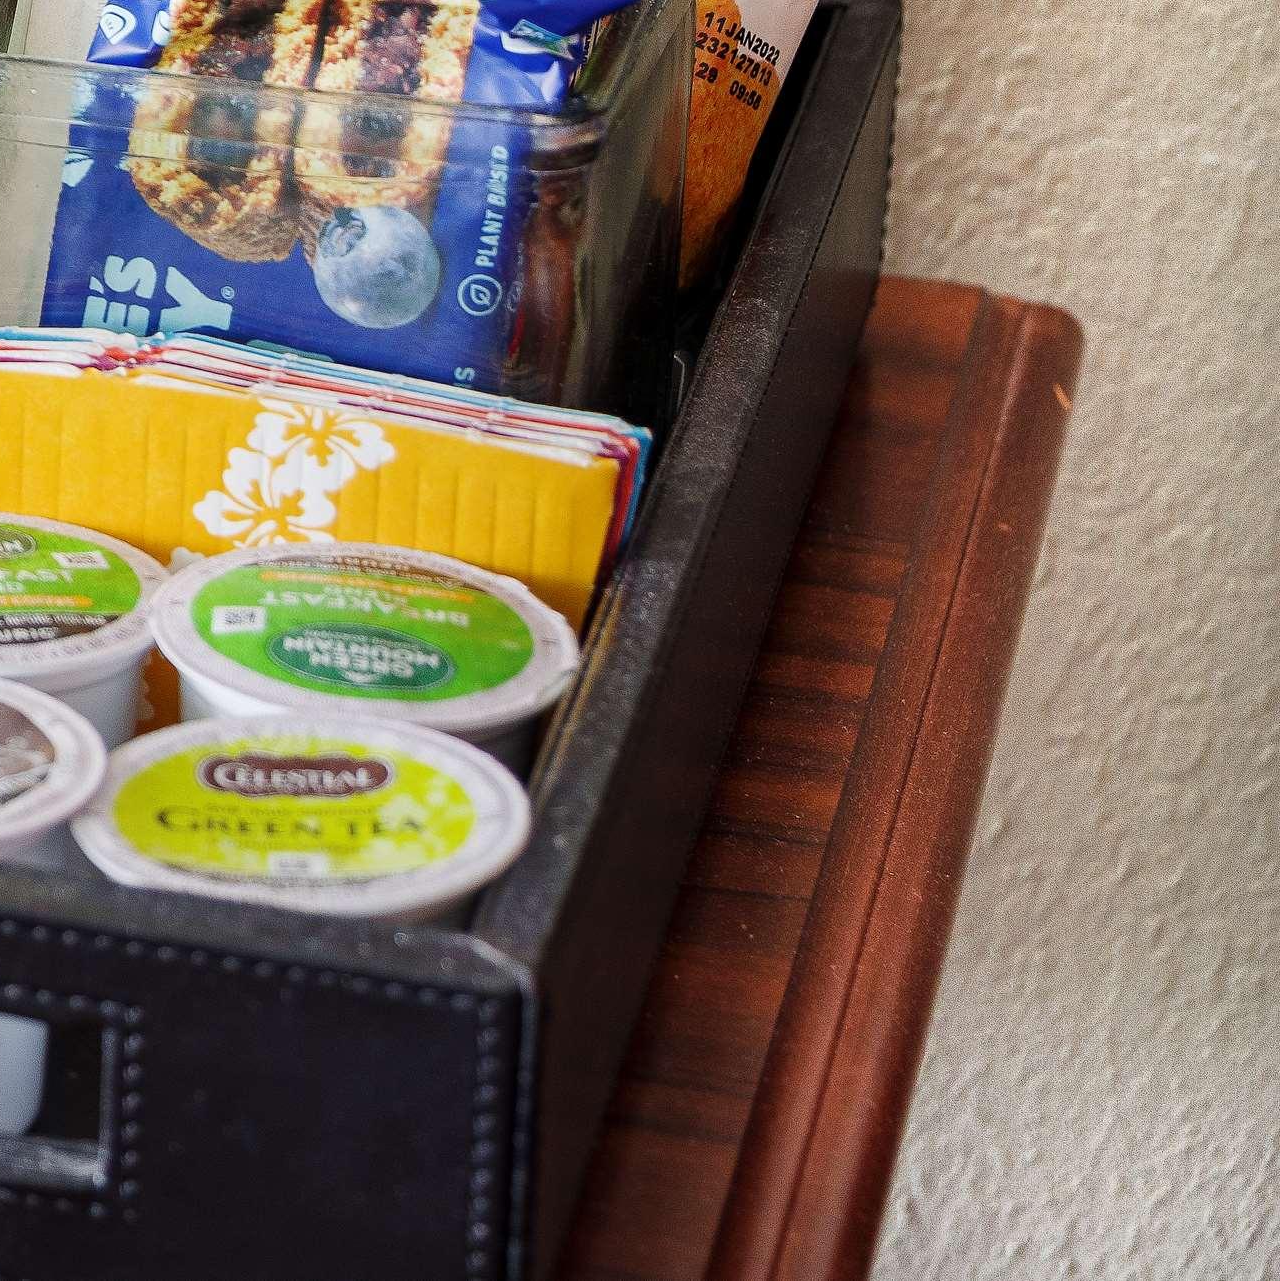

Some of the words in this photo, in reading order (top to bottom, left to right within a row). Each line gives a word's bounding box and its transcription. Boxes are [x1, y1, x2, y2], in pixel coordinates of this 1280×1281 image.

[704, 10, 781, 67] 11JAN2022
[474, 206, 507, 269] PLANT
[212, 762, 372, 791] CELESTIAL
